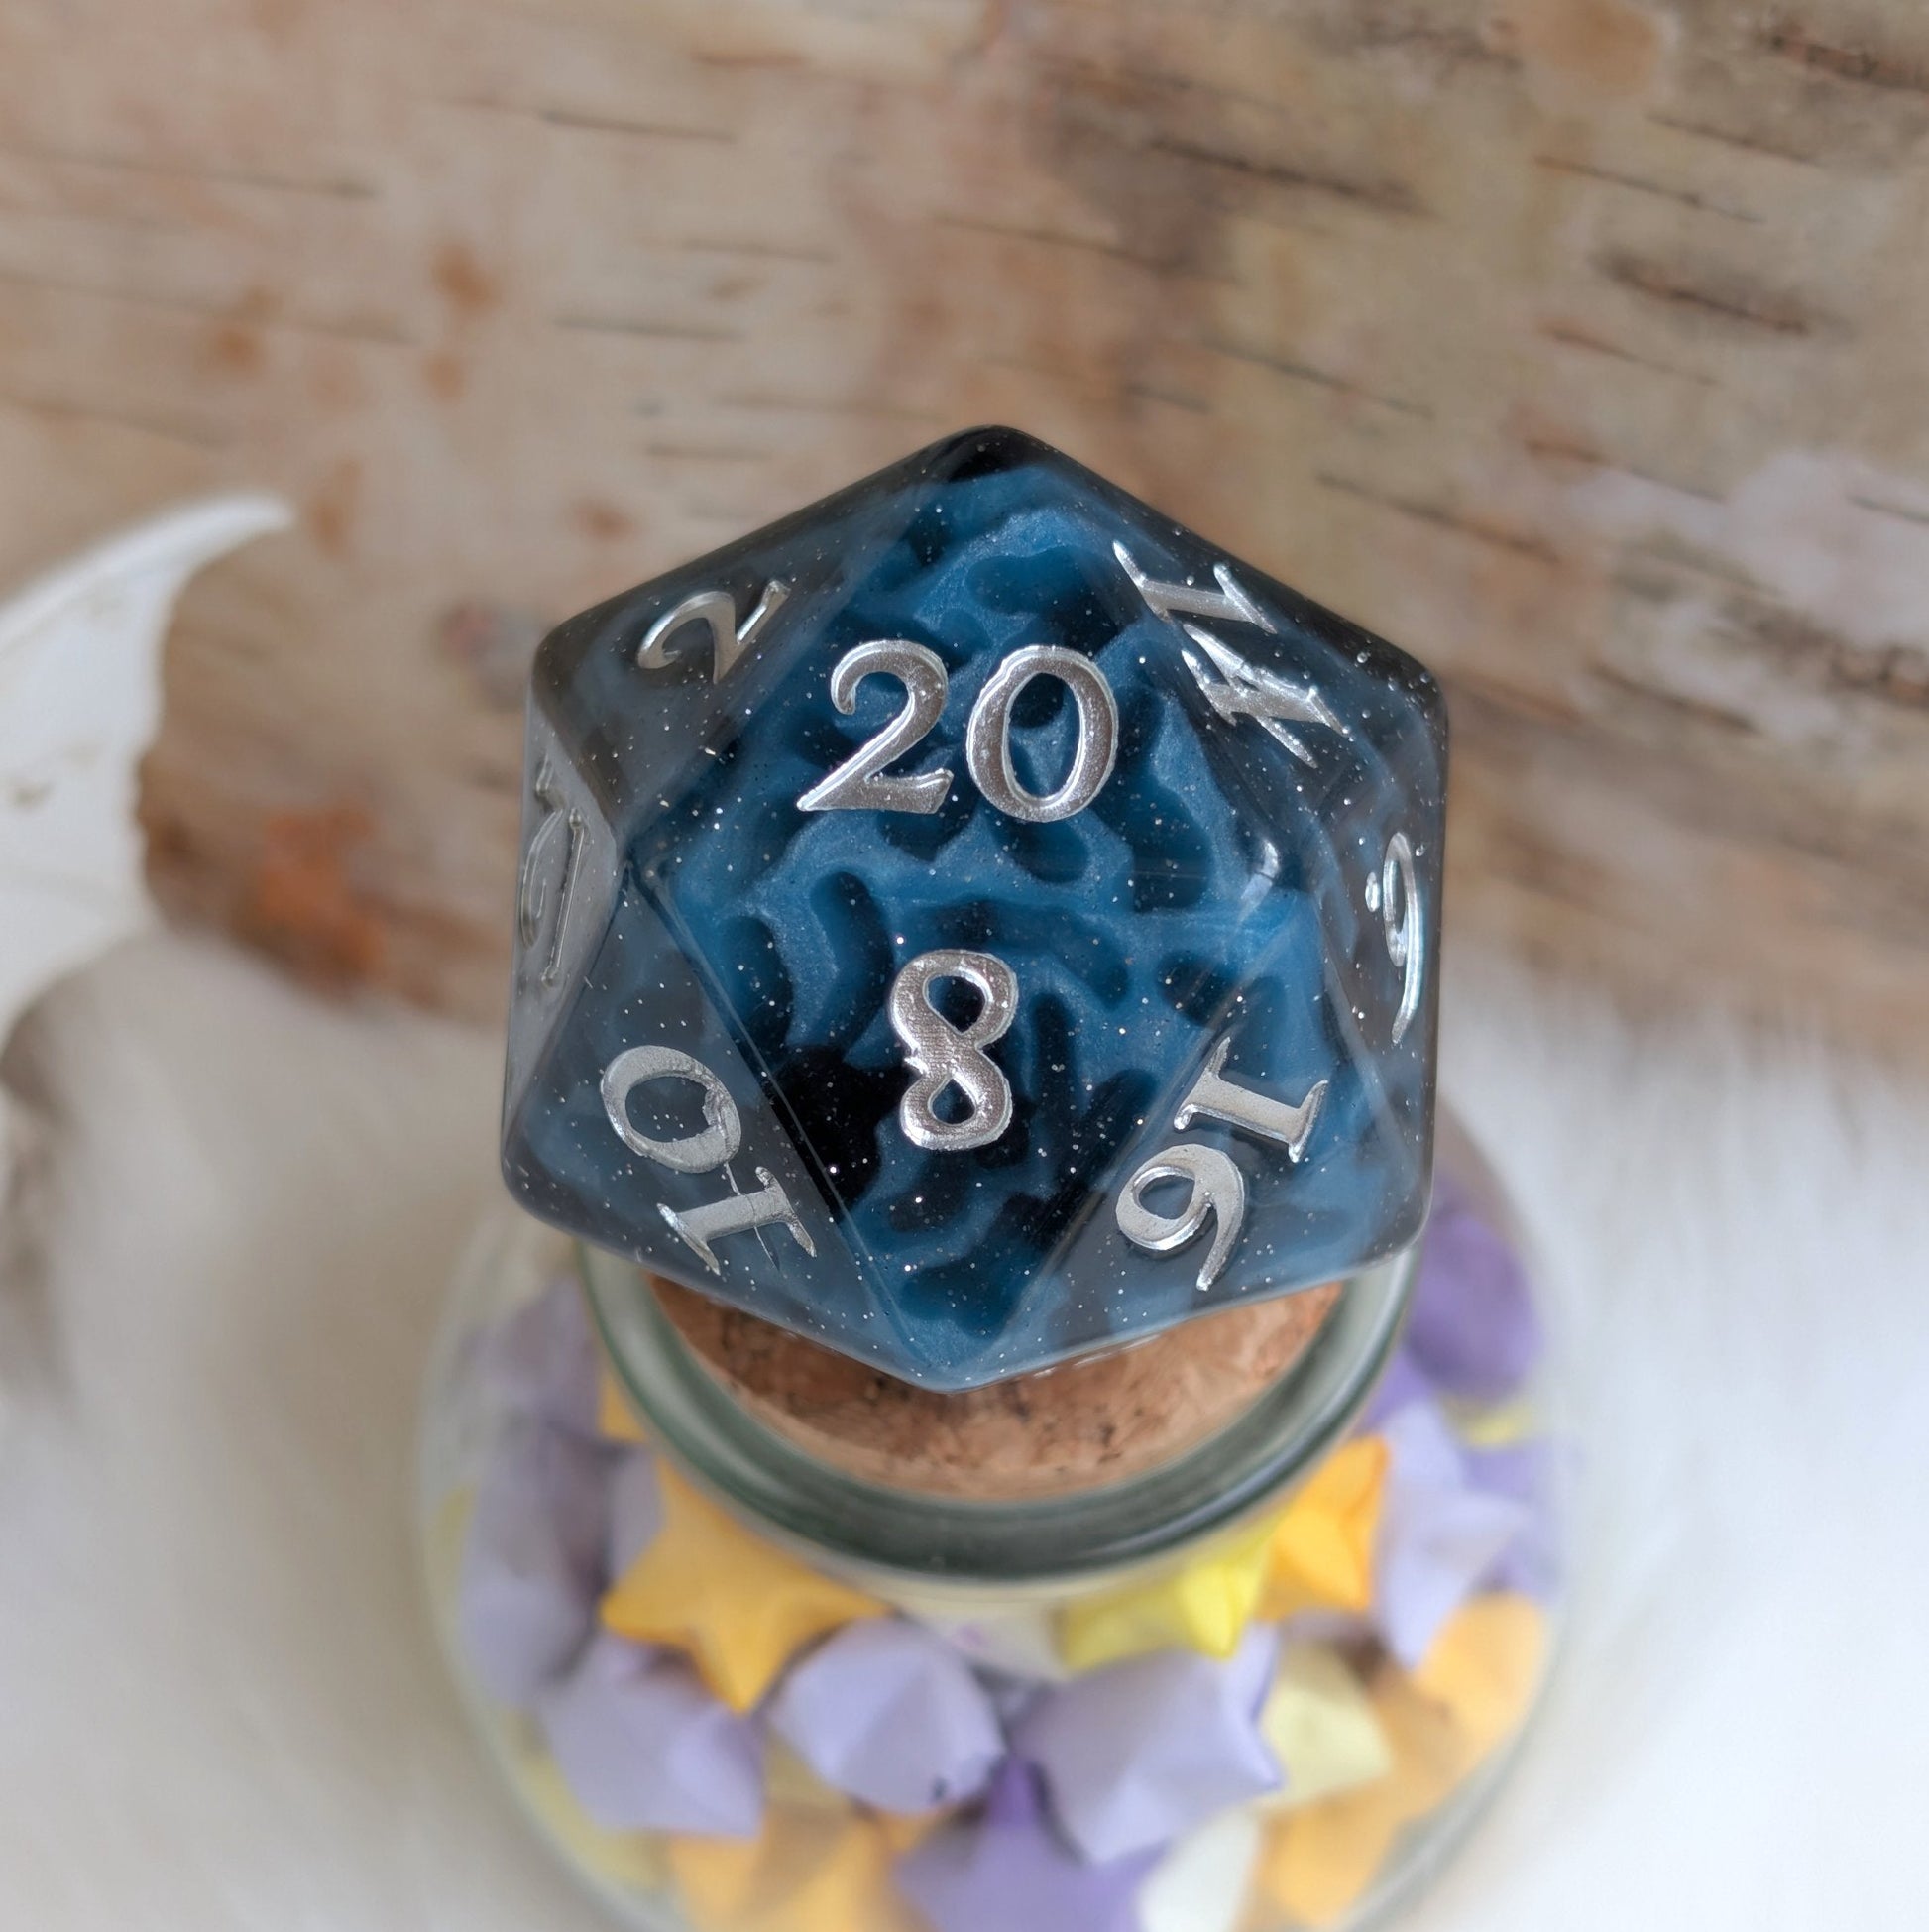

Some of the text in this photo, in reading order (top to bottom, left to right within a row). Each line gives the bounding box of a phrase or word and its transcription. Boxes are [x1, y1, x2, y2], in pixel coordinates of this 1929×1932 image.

[637, 579, 789, 685] 2
[796, 638, 1119, 822] 20
[1110, 538, 1354, 769] 14
[890, 947, 1019, 1152] 8
[599, 1044, 818, 1277] 10
[1114, 1035, 1329, 1292] 16
